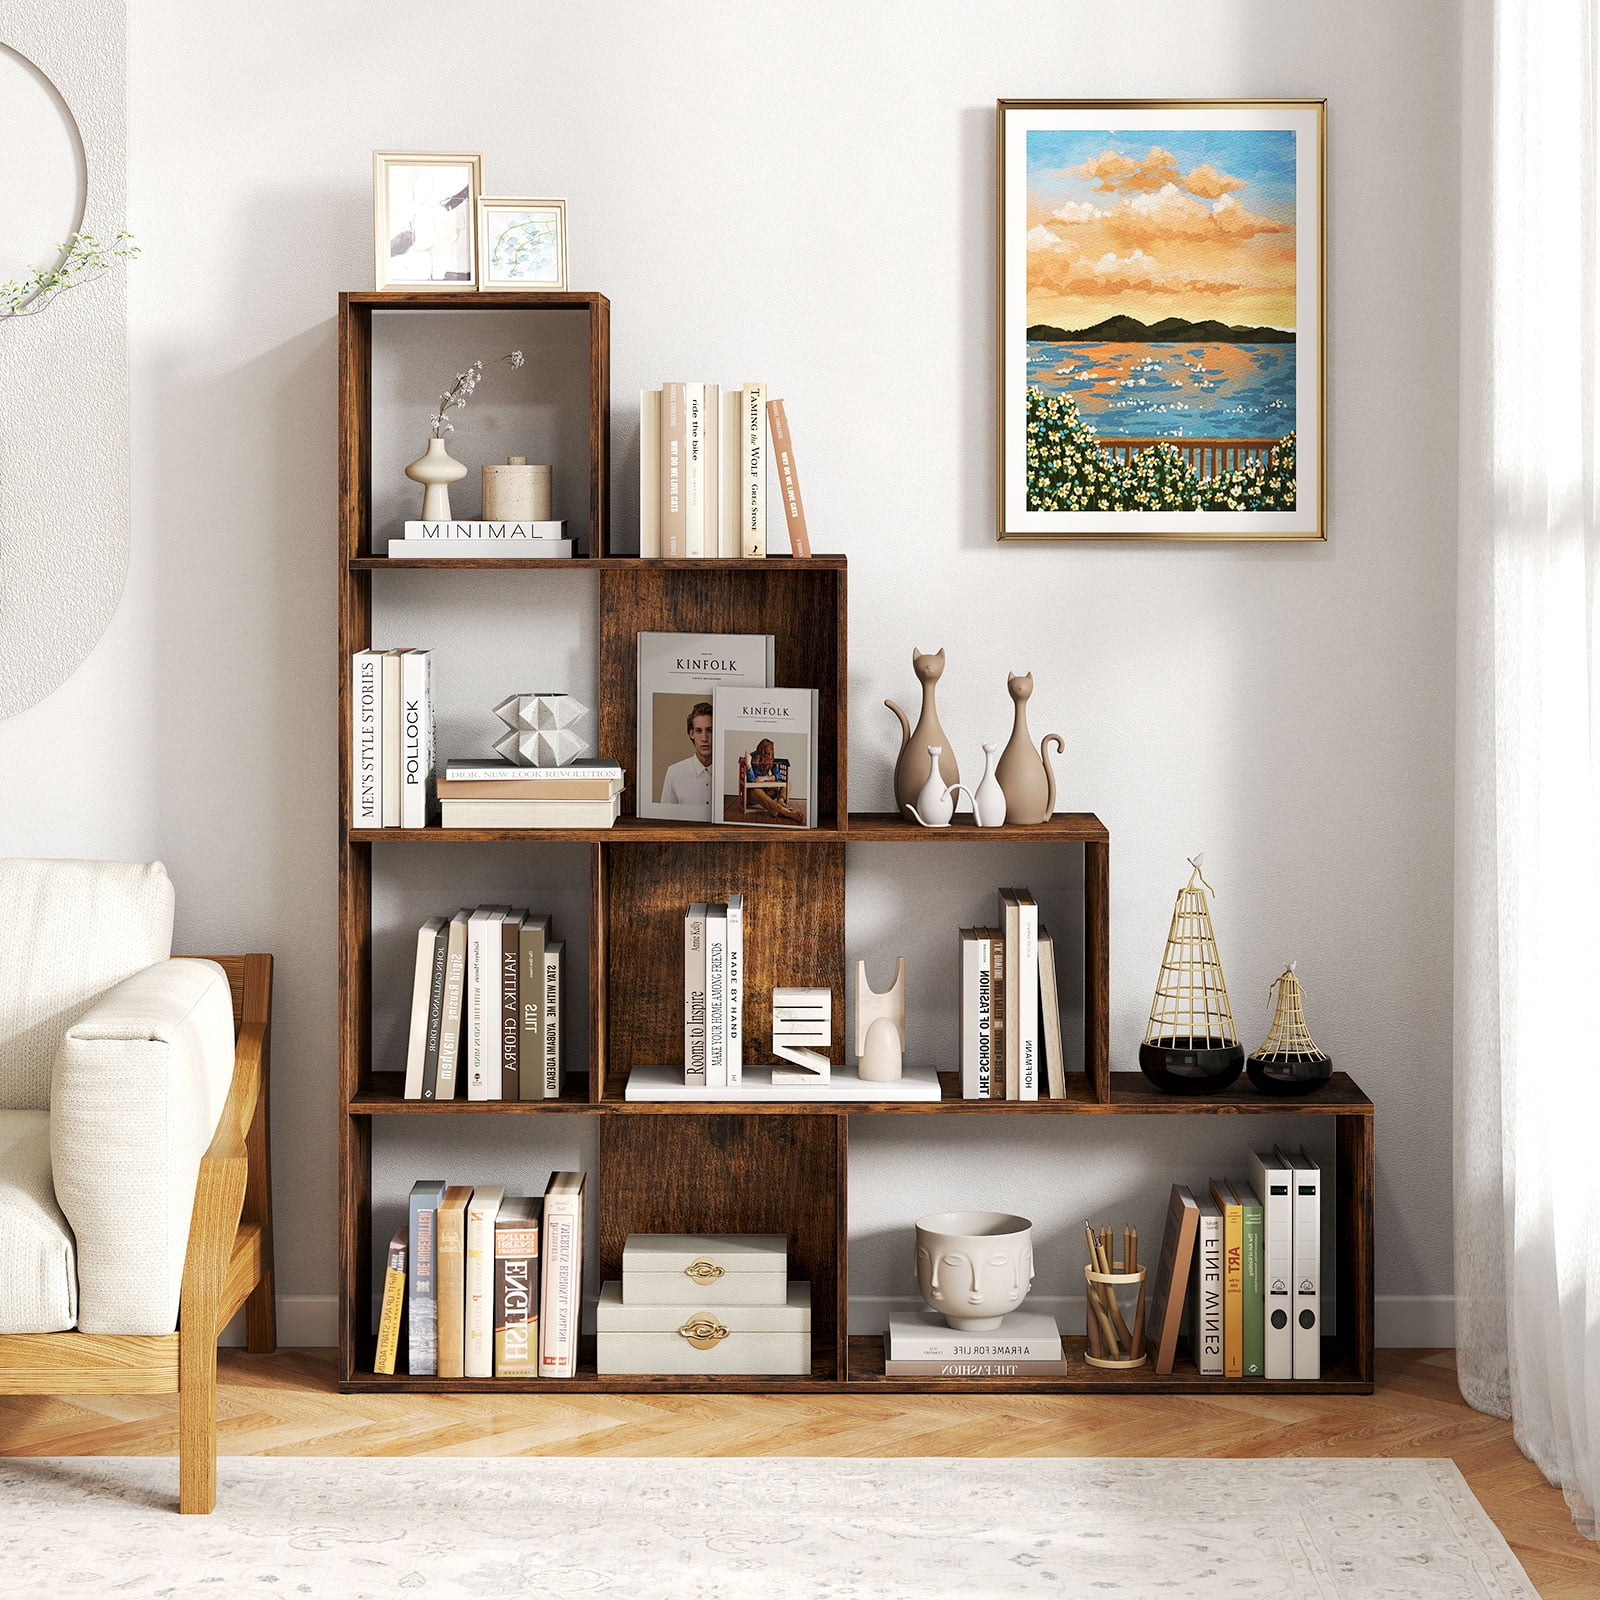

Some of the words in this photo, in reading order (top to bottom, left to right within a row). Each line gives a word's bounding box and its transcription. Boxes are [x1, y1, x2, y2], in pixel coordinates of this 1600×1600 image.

[750, 388, 760, 431] TAMING
[750, 433, 760, 445] the
[670, 440, 679, 456] WHY
[670, 457, 679, 466] DO
[750, 446, 760, 478] WOLF
[780, 452, 789, 466] WHY
[670, 467, 679, 477] WE
[783, 466, 791, 475] DO
[670, 479, 679, 495] LOVE
[785, 476, 792, 486] WE
[751, 483, 759, 505] GREG
[787, 486, 796, 502] LOVE
[670, 496, 679, 513] CATS
[790, 502, 798, 518] CATS
[751, 506, 759, 532] STONE
[422, 524, 543, 538] MINIMAL
[676, 658, 737, 671] KINFOLK
[362, 662, 374, 722] STORIES
[742, 706, 789, 716] KINFOLK
[362, 726, 374, 771] STYLE
[407, 700, 418, 784] POLLOCK
[545, 770, 616, 778] REVOLUTION
[690, 921, 703, 935] Kelly
[690, 936, 700, 952] Annie
[711, 942, 722, 972] FRIENDS
[711, 974, 722, 1001] AMONG
[730, 988, 737, 1002] BY
[686, 991, 706, 1025] Inspire
[711, 1002, 722, 1023] HOME
[688, 1028, 704, 1038] to
[711, 1024, 722, 1045] YOUR
[686, 1040, 704, 1075] Rooms
[711, 1046, 722, 1066] MAKE
